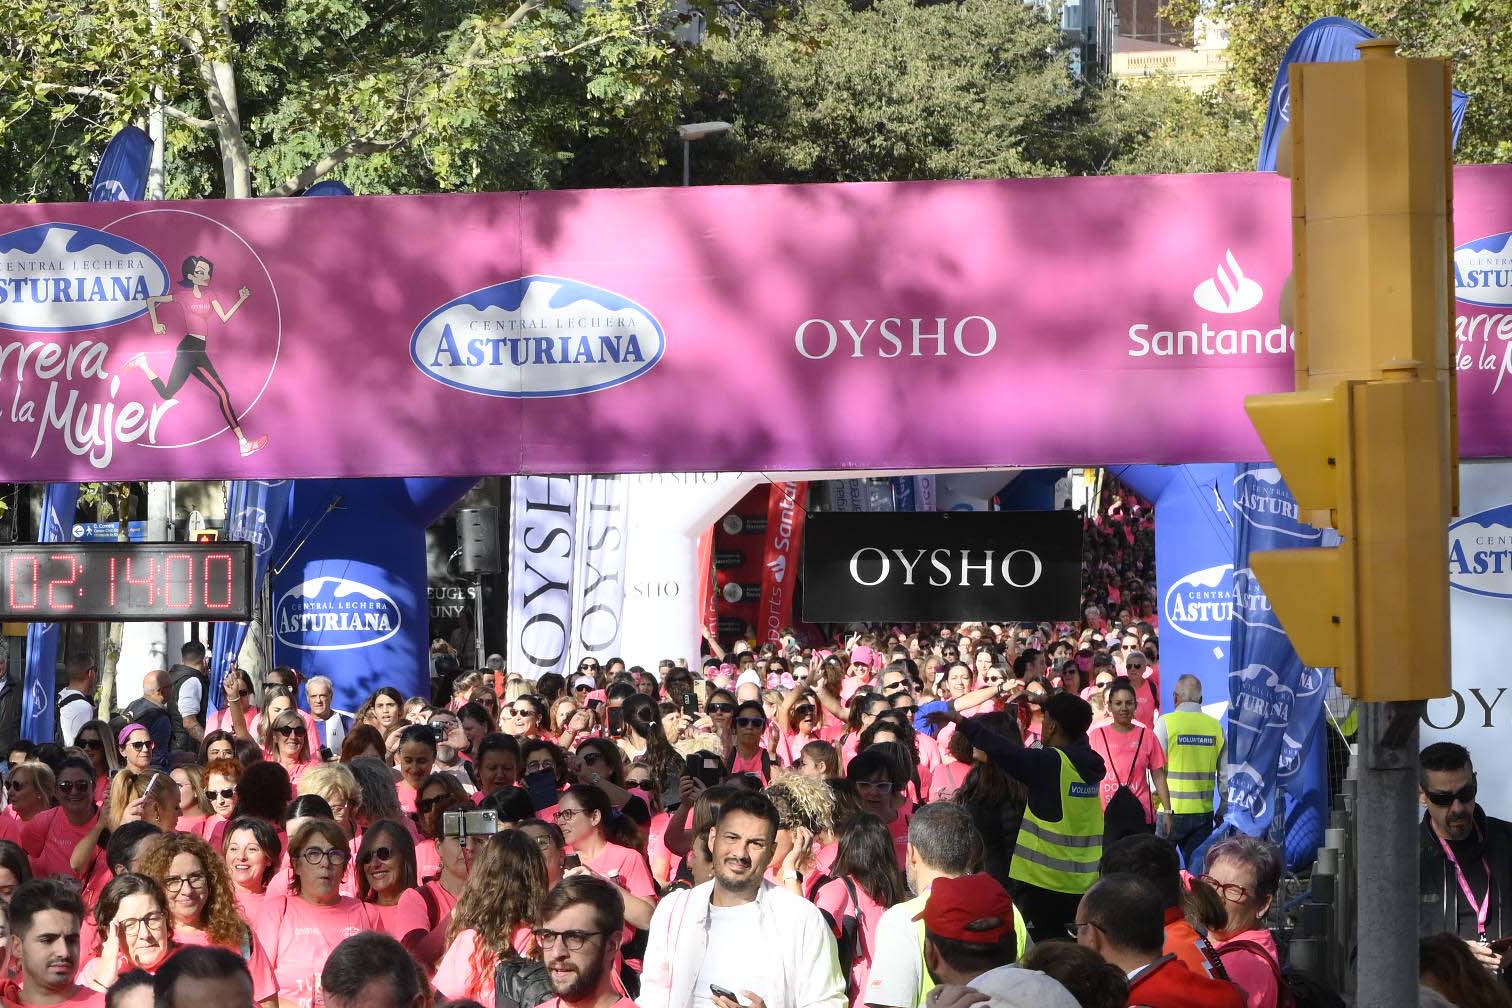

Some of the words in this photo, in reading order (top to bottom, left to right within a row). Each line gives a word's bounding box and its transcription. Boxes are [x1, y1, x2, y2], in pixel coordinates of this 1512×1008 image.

[72, 259, 145, 270] LECHERA
[1455, 261, 1512, 288] ASTU
[469, 318, 548, 331] CENTRAL
[557, 317, 637, 329] LECHERA
[794, 315, 997, 360] OYSHO
[430, 323, 646, 367] ASTURIANA
[1128, 323, 1297, 357] Santand
[1479, 342, 1497, 370] la
[11, 384, 35, 423] la
[31, 374, 180, 468] Mujer
[849, 547, 1043, 588] OYSHO
[1449, 539, 1512, 574] AST
[292, 602, 334, 610] CENTRAL
[338, 601, 387, 610] LECHERA
[279, 606, 392, 634] ASTURIANA
[1178, 736, 1214, 745] VOLUNTARIS
